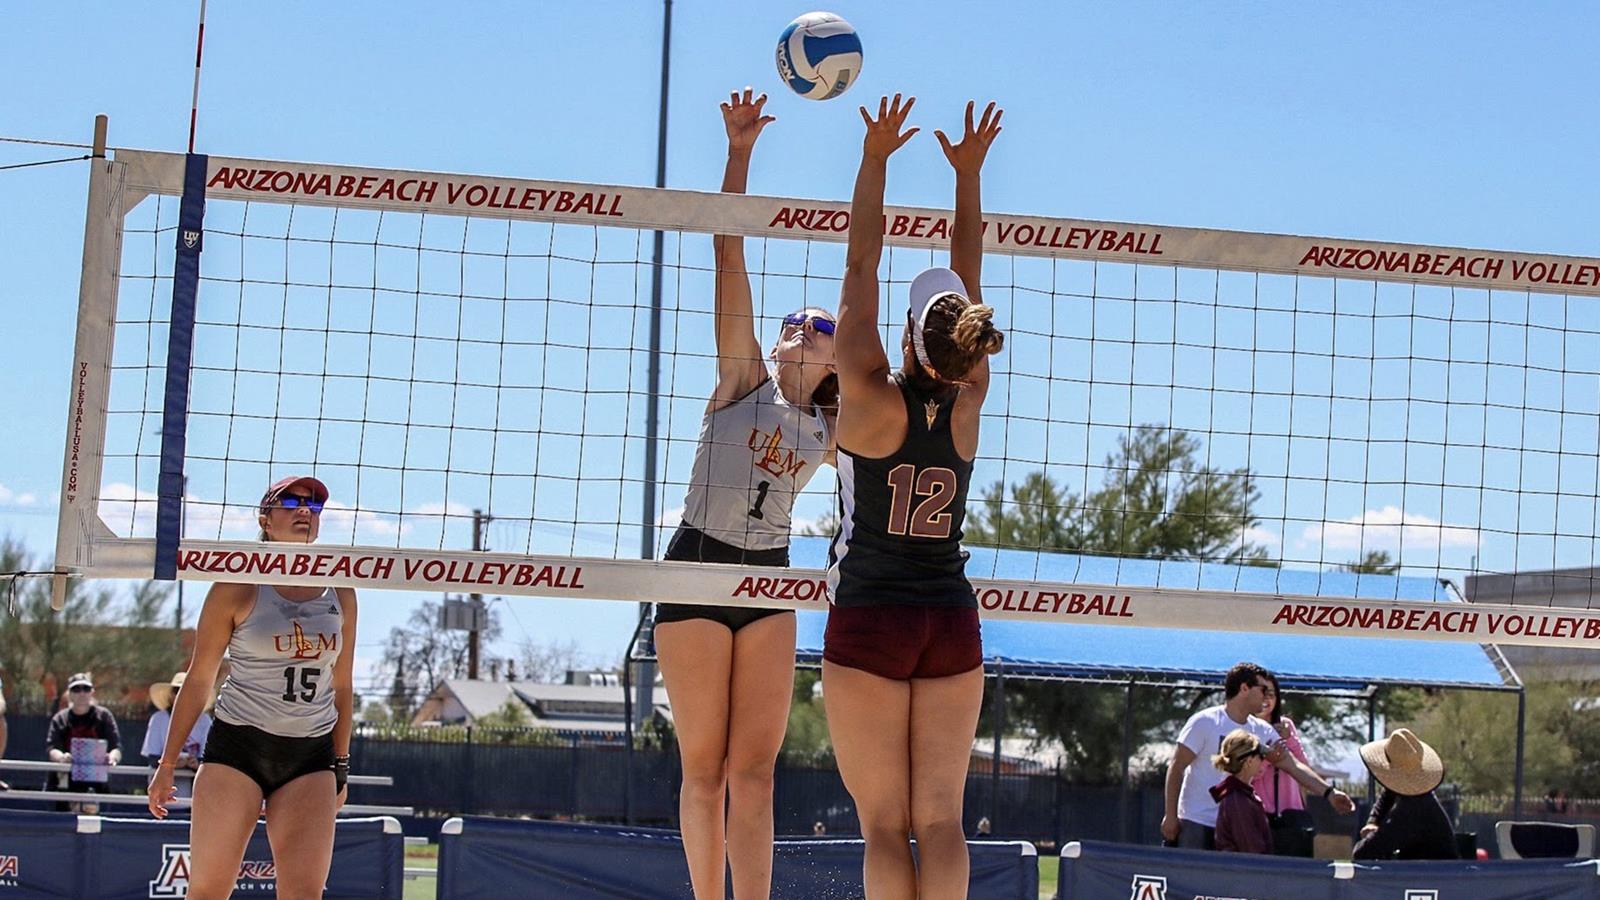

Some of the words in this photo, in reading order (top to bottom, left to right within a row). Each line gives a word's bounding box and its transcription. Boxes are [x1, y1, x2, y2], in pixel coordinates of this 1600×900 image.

[447, 182, 624, 217] VOLLEYBALL
[997, 222, 1163, 255] VOLLEYBALL
[748, 480, 770, 520] 1
[887, 463, 957, 538] 12
[404, 559, 584, 589] VOLLEYBALL
[731, 576, 830, 602] ARIZON
[976, 587, 1134, 617] OLLEYBALL
[1486, 613, 1600, 639] VOLLEYB
[282, 666, 321, 703] 15
